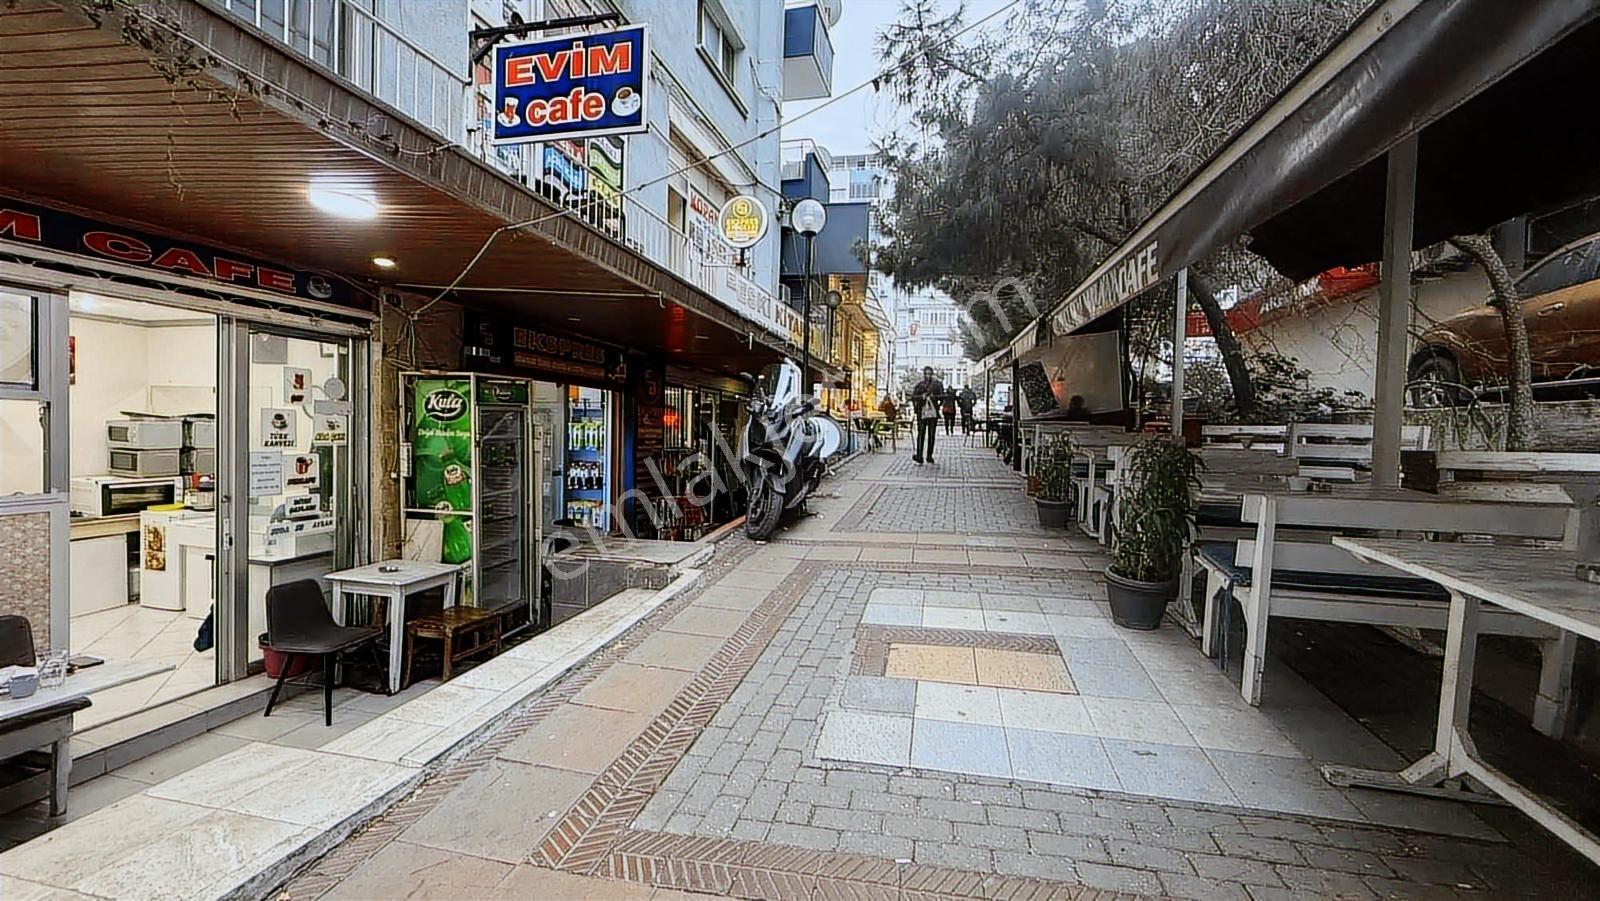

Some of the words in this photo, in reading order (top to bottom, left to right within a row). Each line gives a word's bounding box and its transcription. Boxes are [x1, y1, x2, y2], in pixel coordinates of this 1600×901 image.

[505, 41, 632, 88] EVİM
[526, 87, 605, 127] cafe
[83, 231, 296, 294] CAFE
[1118, 240, 1160, 300] CAFE
[427, 393, 463, 411] Kula
[270, 431, 289, 440] TÜRK
